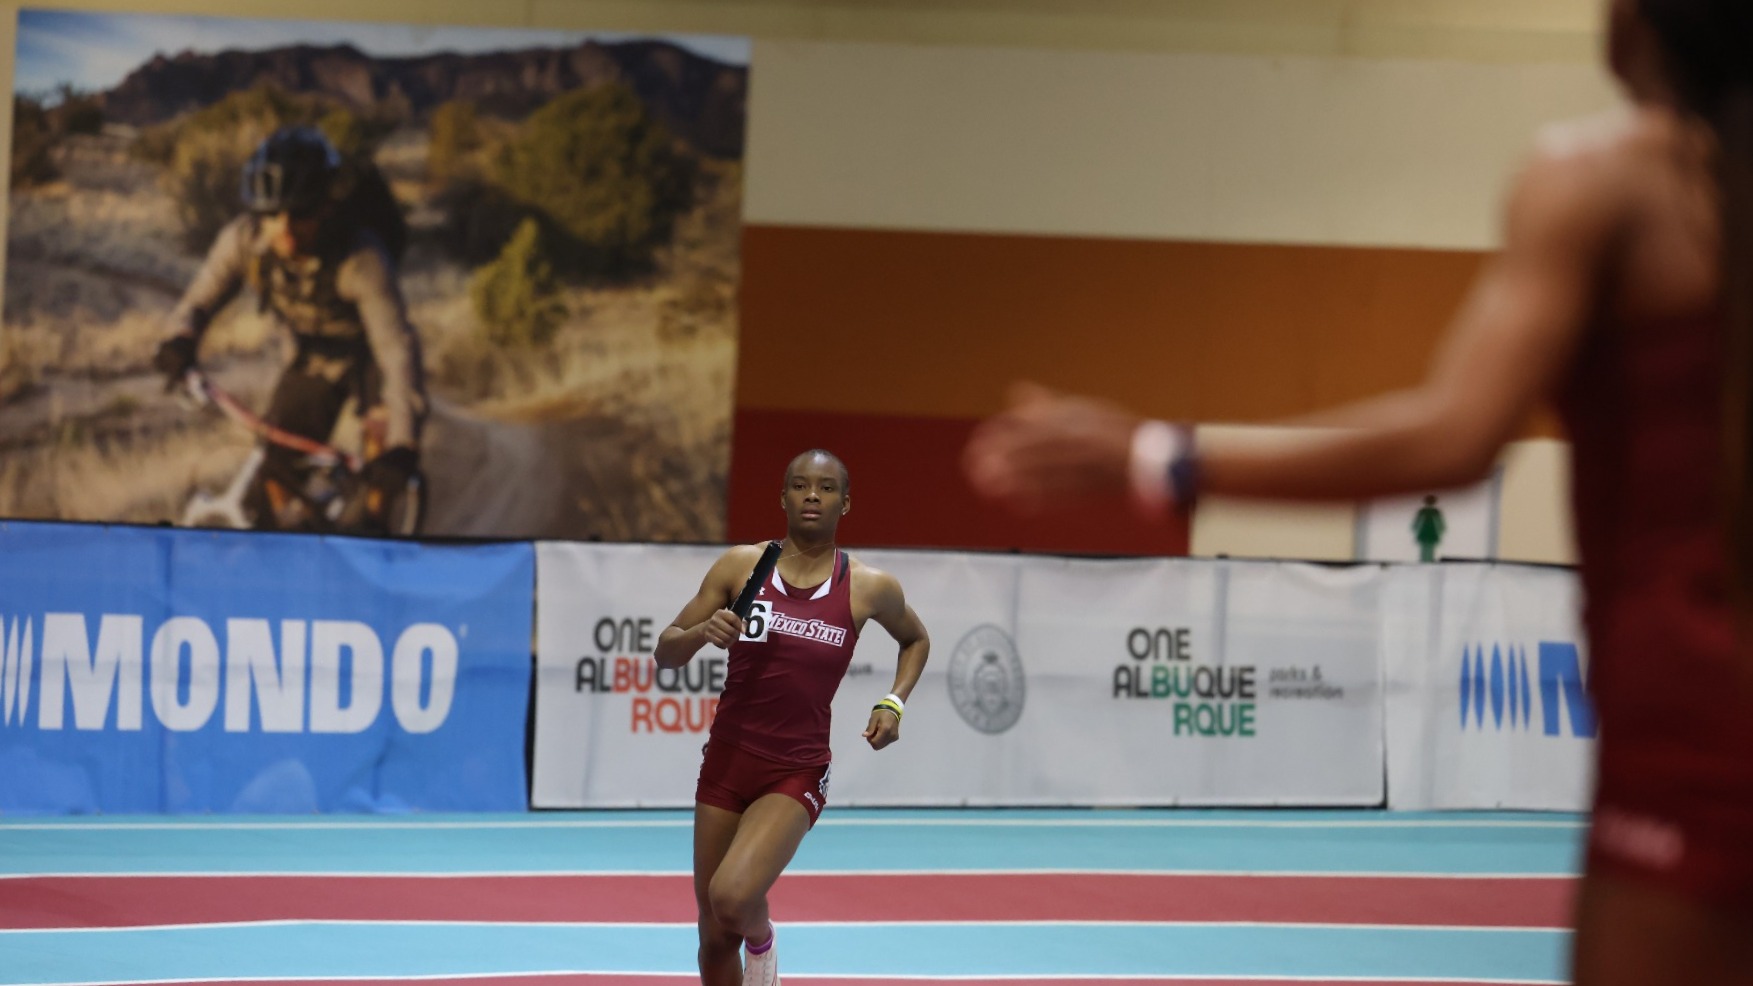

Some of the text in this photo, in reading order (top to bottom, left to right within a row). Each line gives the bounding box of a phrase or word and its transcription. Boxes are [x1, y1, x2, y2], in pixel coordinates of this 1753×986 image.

[594, 617, 653, 652] ONE
[744, 603, 766, 639] 6
[806, 620, 843, 644] STATE
[1127, 628, 1191, 661] ONE
[38, 612, 459, 734] MONDO
[575, 656, 725, 693] ALBUQUE
[1113, 666, 1256, 699] ALBUQUE
[1173, 702, 1256, 736] RQUE
